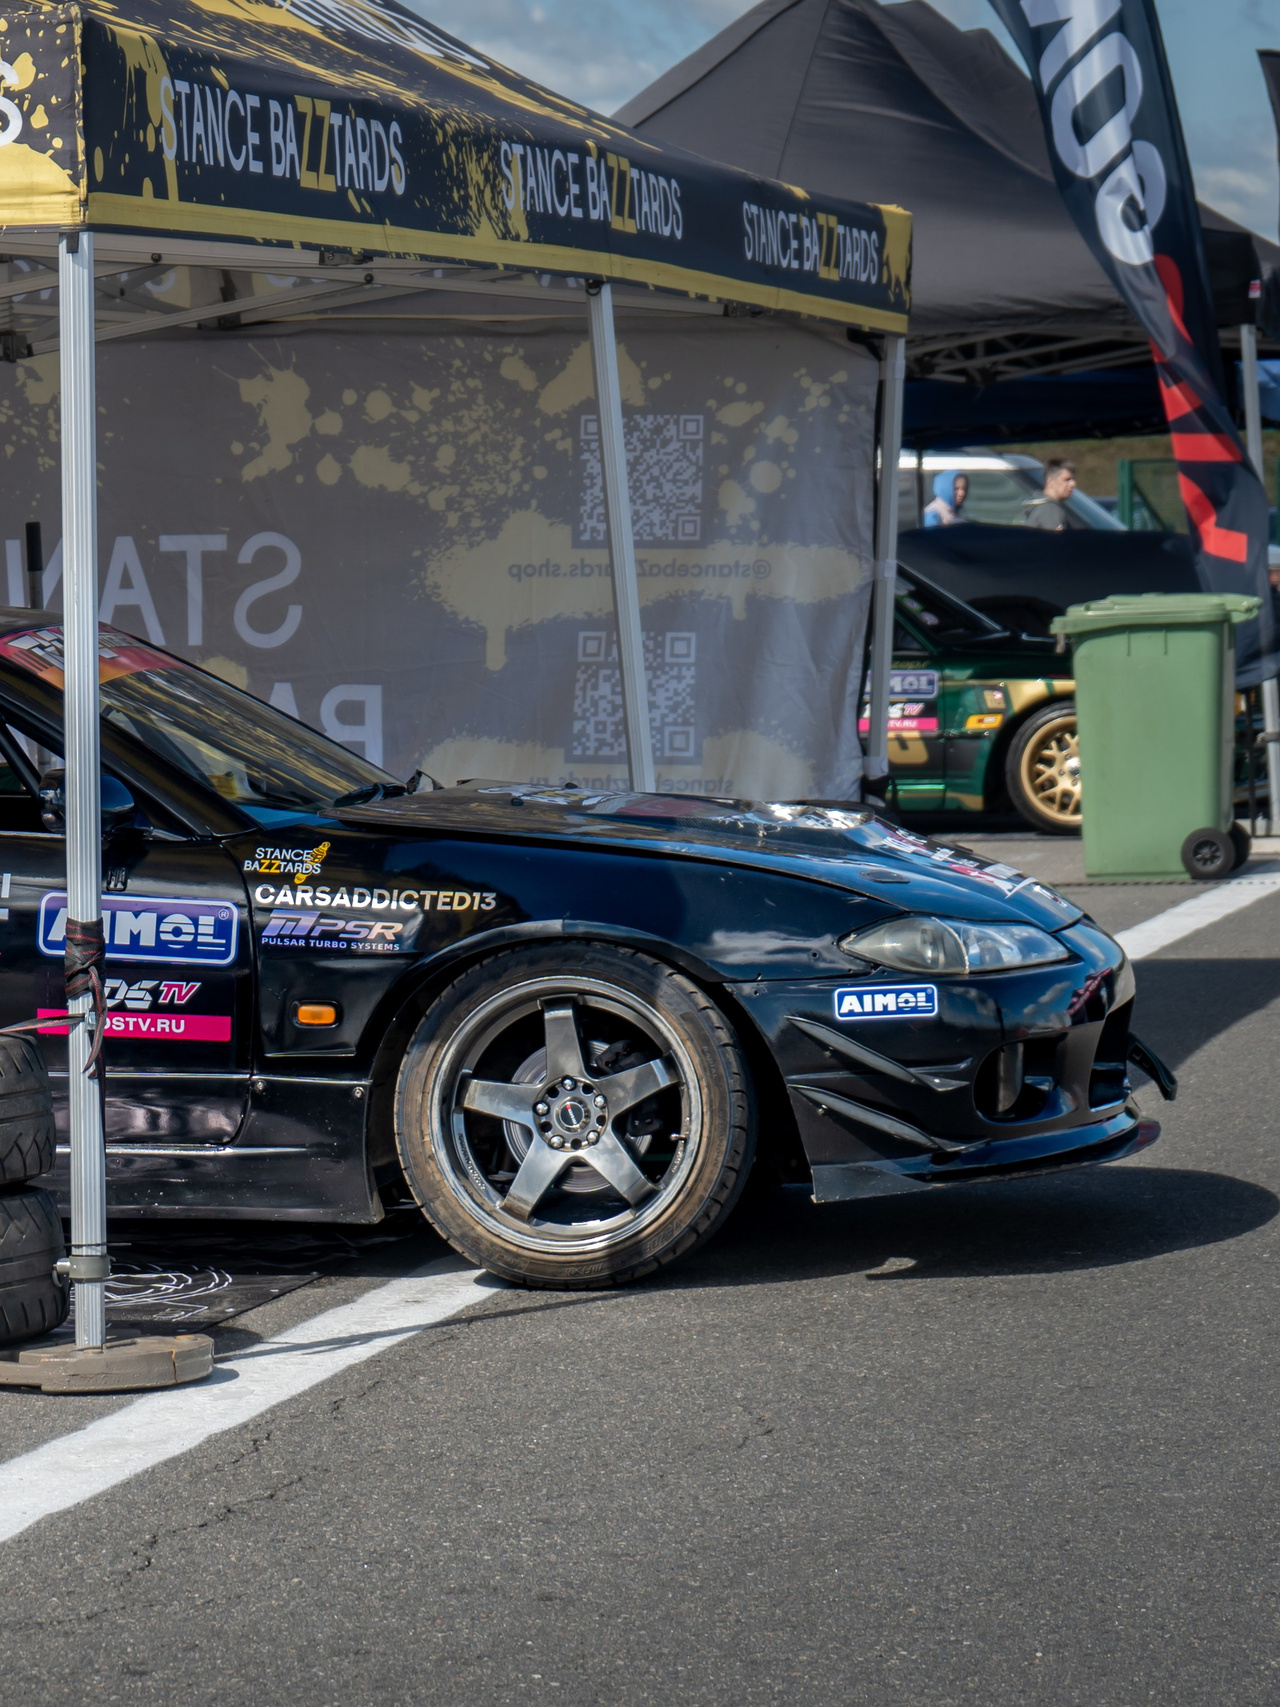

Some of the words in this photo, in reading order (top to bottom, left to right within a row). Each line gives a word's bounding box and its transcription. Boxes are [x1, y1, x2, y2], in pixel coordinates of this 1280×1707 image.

[160, 77, 263, 173] STANCE
[271, 96, 406, 196] BAZZTARDS
[501, 140, 580, 219] STANCE
[588, 153, 682, 240] BAZZTARDS
[743, 201, 799, 270] STANCE
[804, 211, 878, 284] BAZZTARDS
[243, 859, 322, 874] BAZZTARDS
[254, 847, 312, 861] STANCE
[254, 883, 497, 911] CARSADDICTED13
[261, 936, 306, 947] PULSAR
[309, 938, 347, 949] TURBO
[350, 941, 400, 951] SYSTEMS
[158, 980, 202, 1005] TV
[839, 991, 933, 1014] AIMOL
